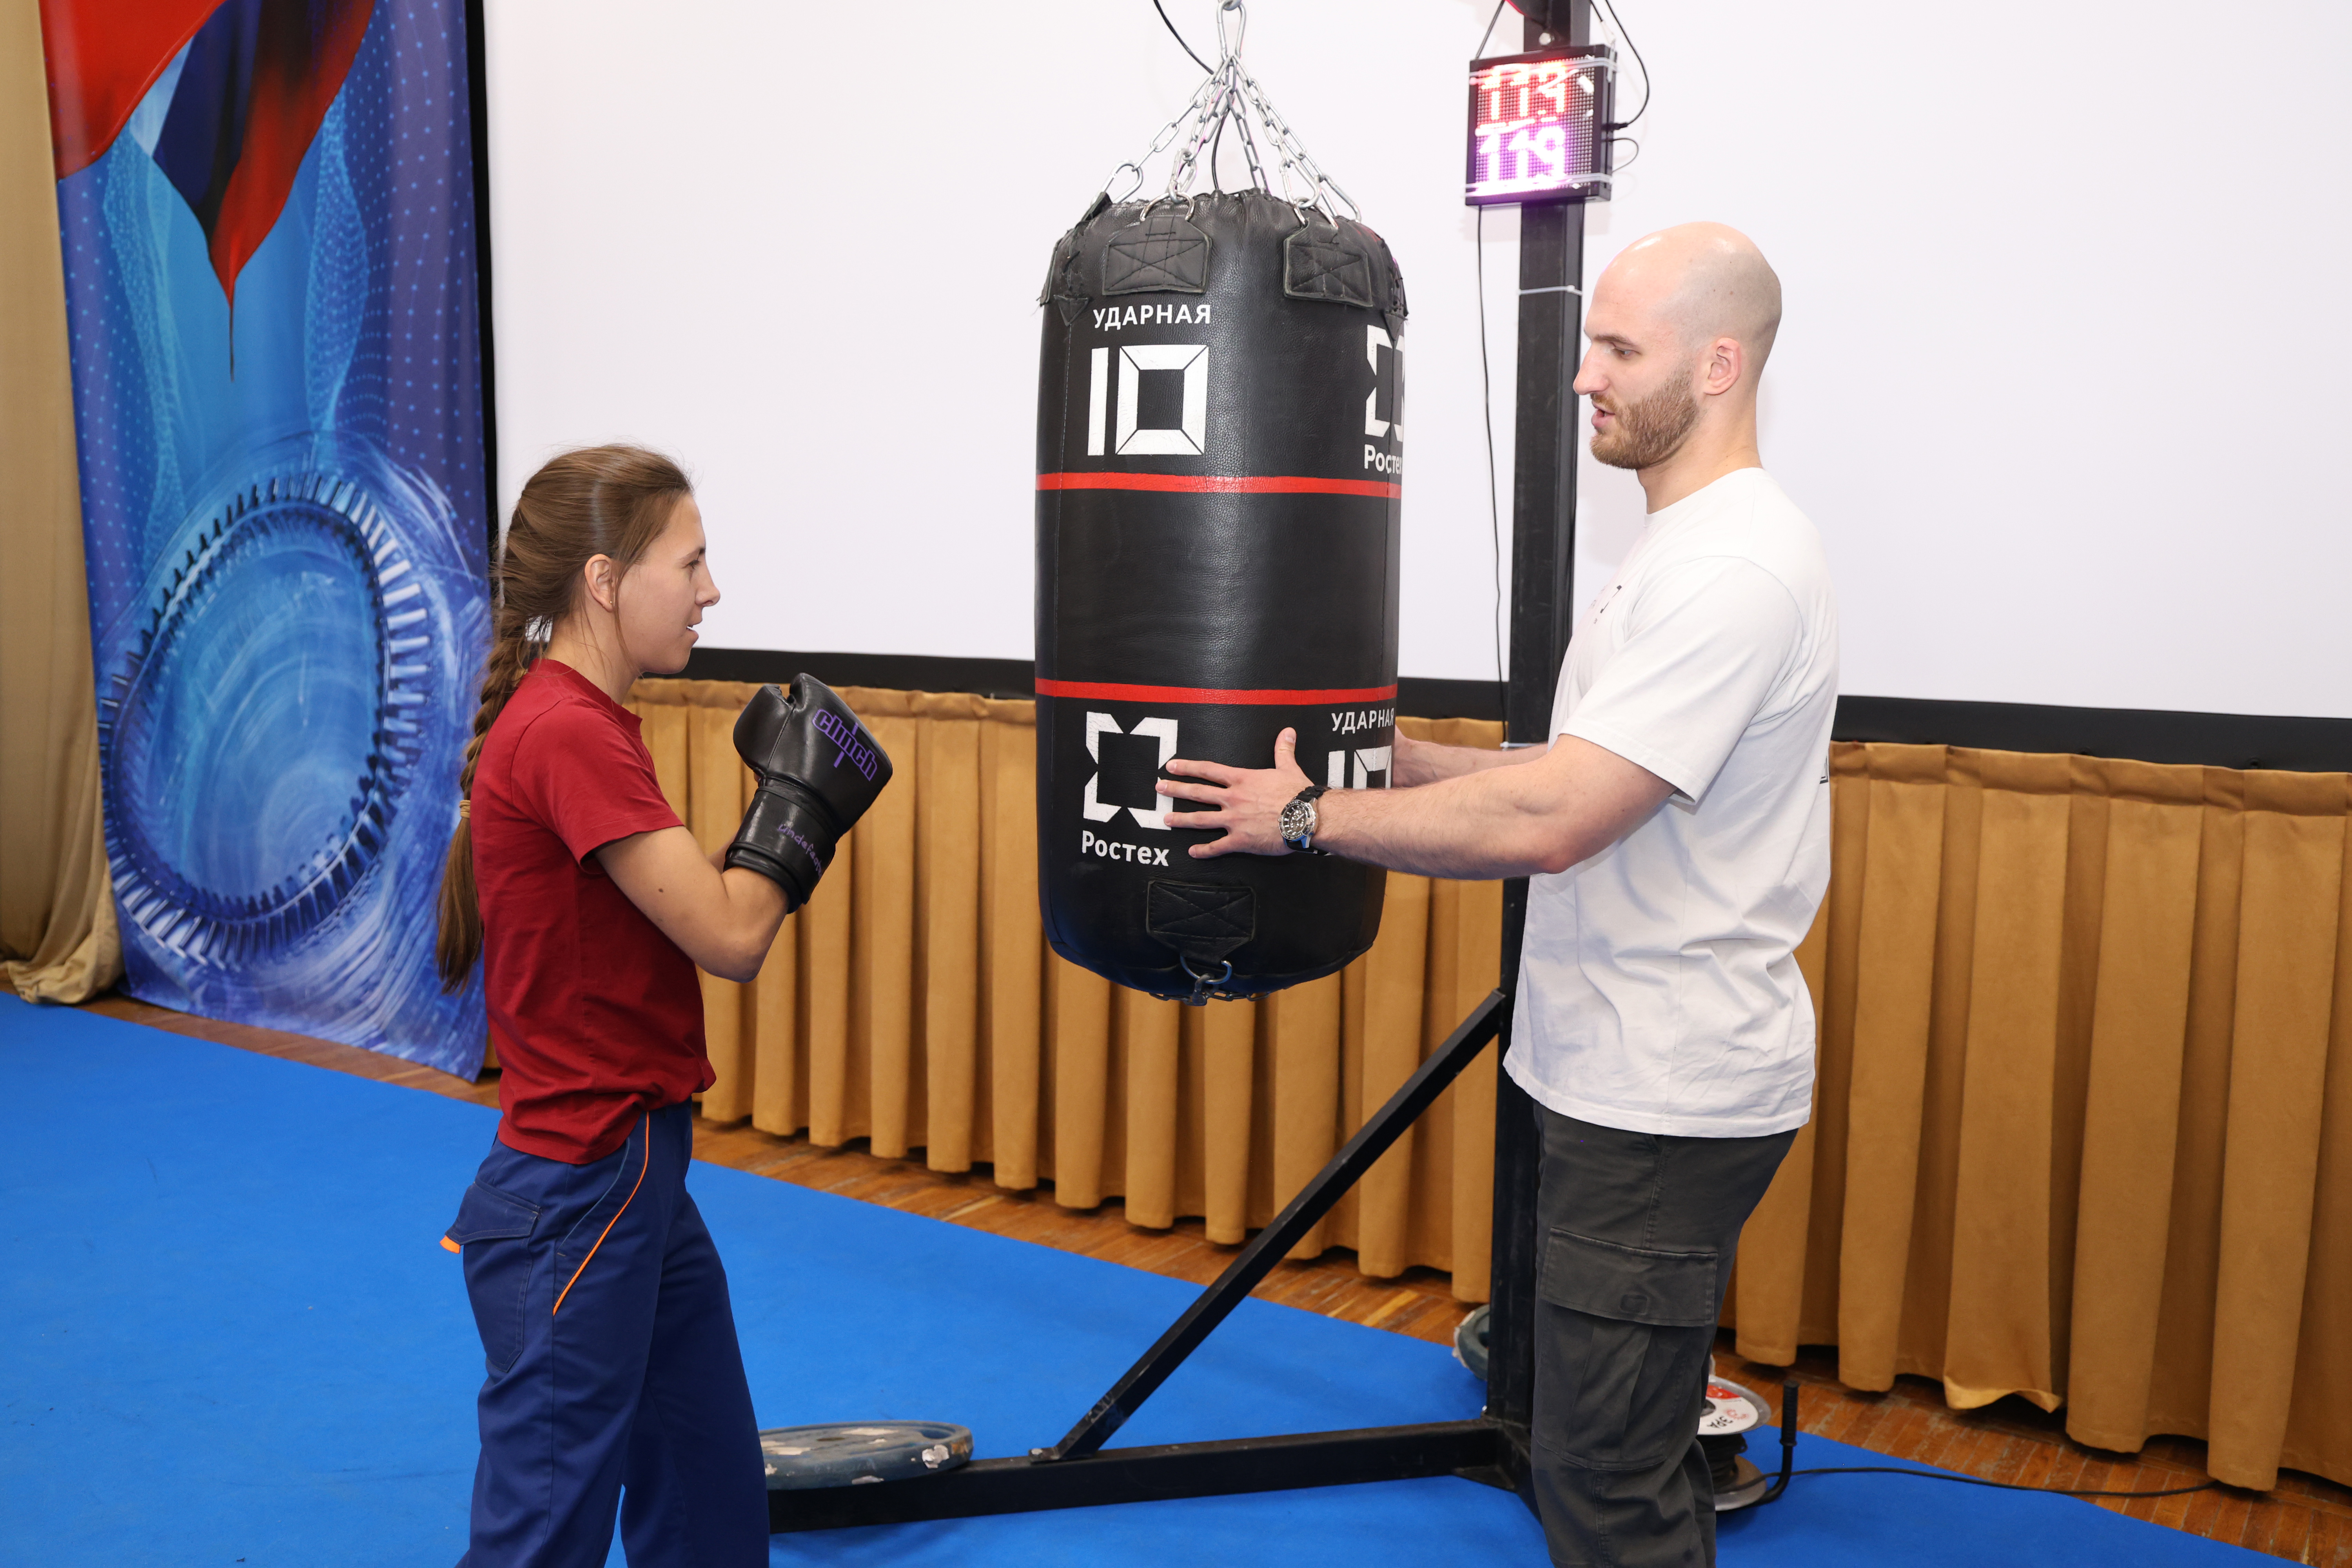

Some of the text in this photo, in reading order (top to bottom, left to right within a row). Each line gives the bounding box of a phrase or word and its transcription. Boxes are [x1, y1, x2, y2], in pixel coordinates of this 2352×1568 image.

[1093, 304, 1211, 330] УДАРНАЯ
[1364, 444, 1402, 474] Ростех
[1331, 708, 1394, 735] УДАРНАЯ
[812, 709, 878, 782] clinch
[1082, 830, 1169, 866] Ростех
